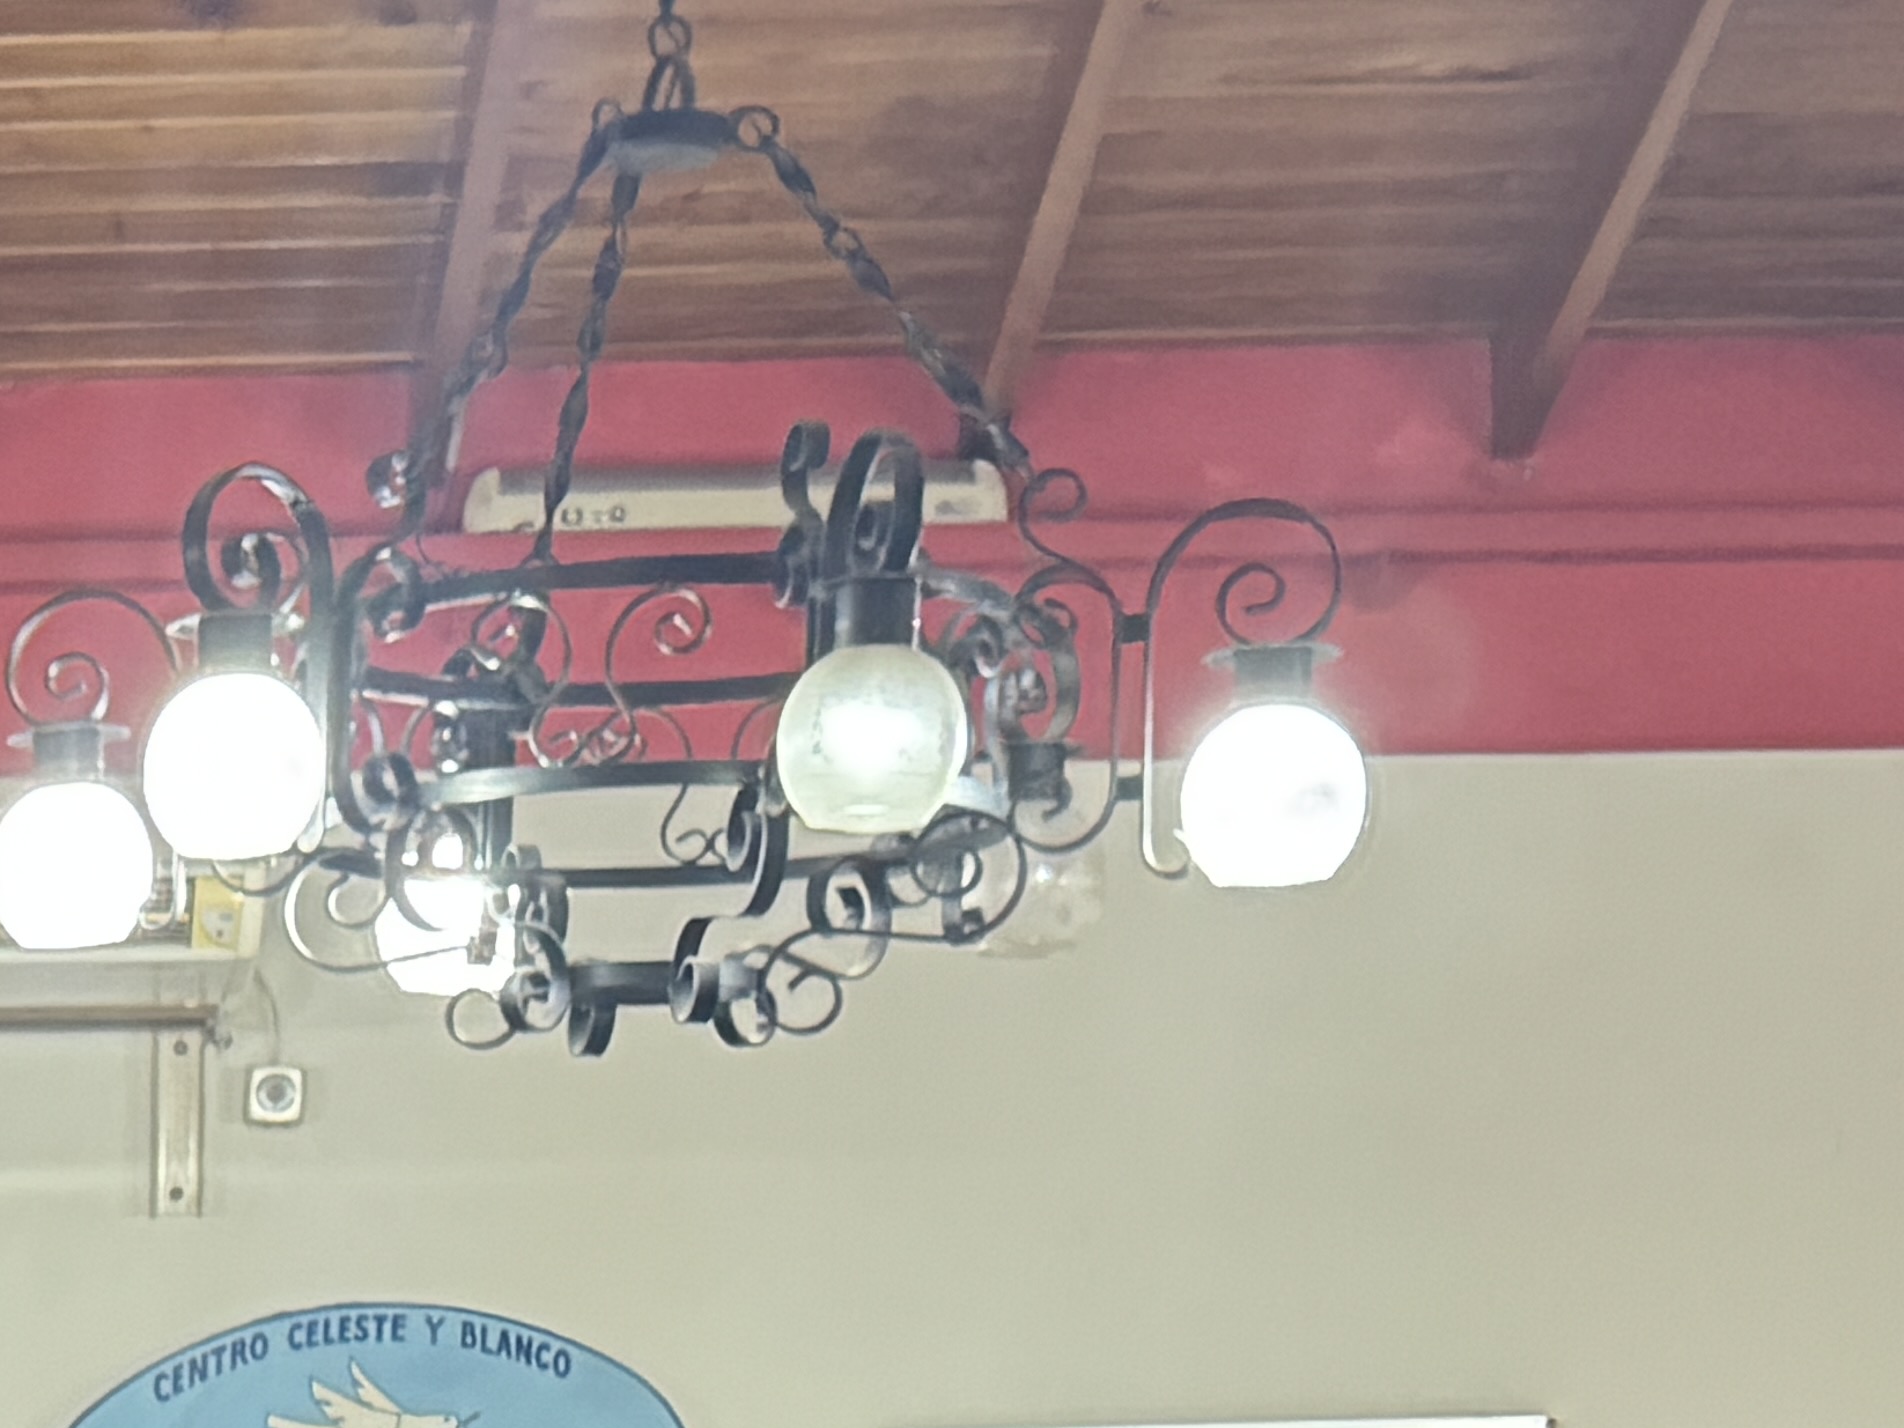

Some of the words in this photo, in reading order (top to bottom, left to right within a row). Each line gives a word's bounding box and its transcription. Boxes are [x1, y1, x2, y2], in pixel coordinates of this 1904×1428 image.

[153, 1331, 269, 1402] CENTRO
[288, 1313, 406, 1352] CELESTE
[426, 1316, 447, 1346] Y
[460, 1320, 572, 1379] BLANCO
